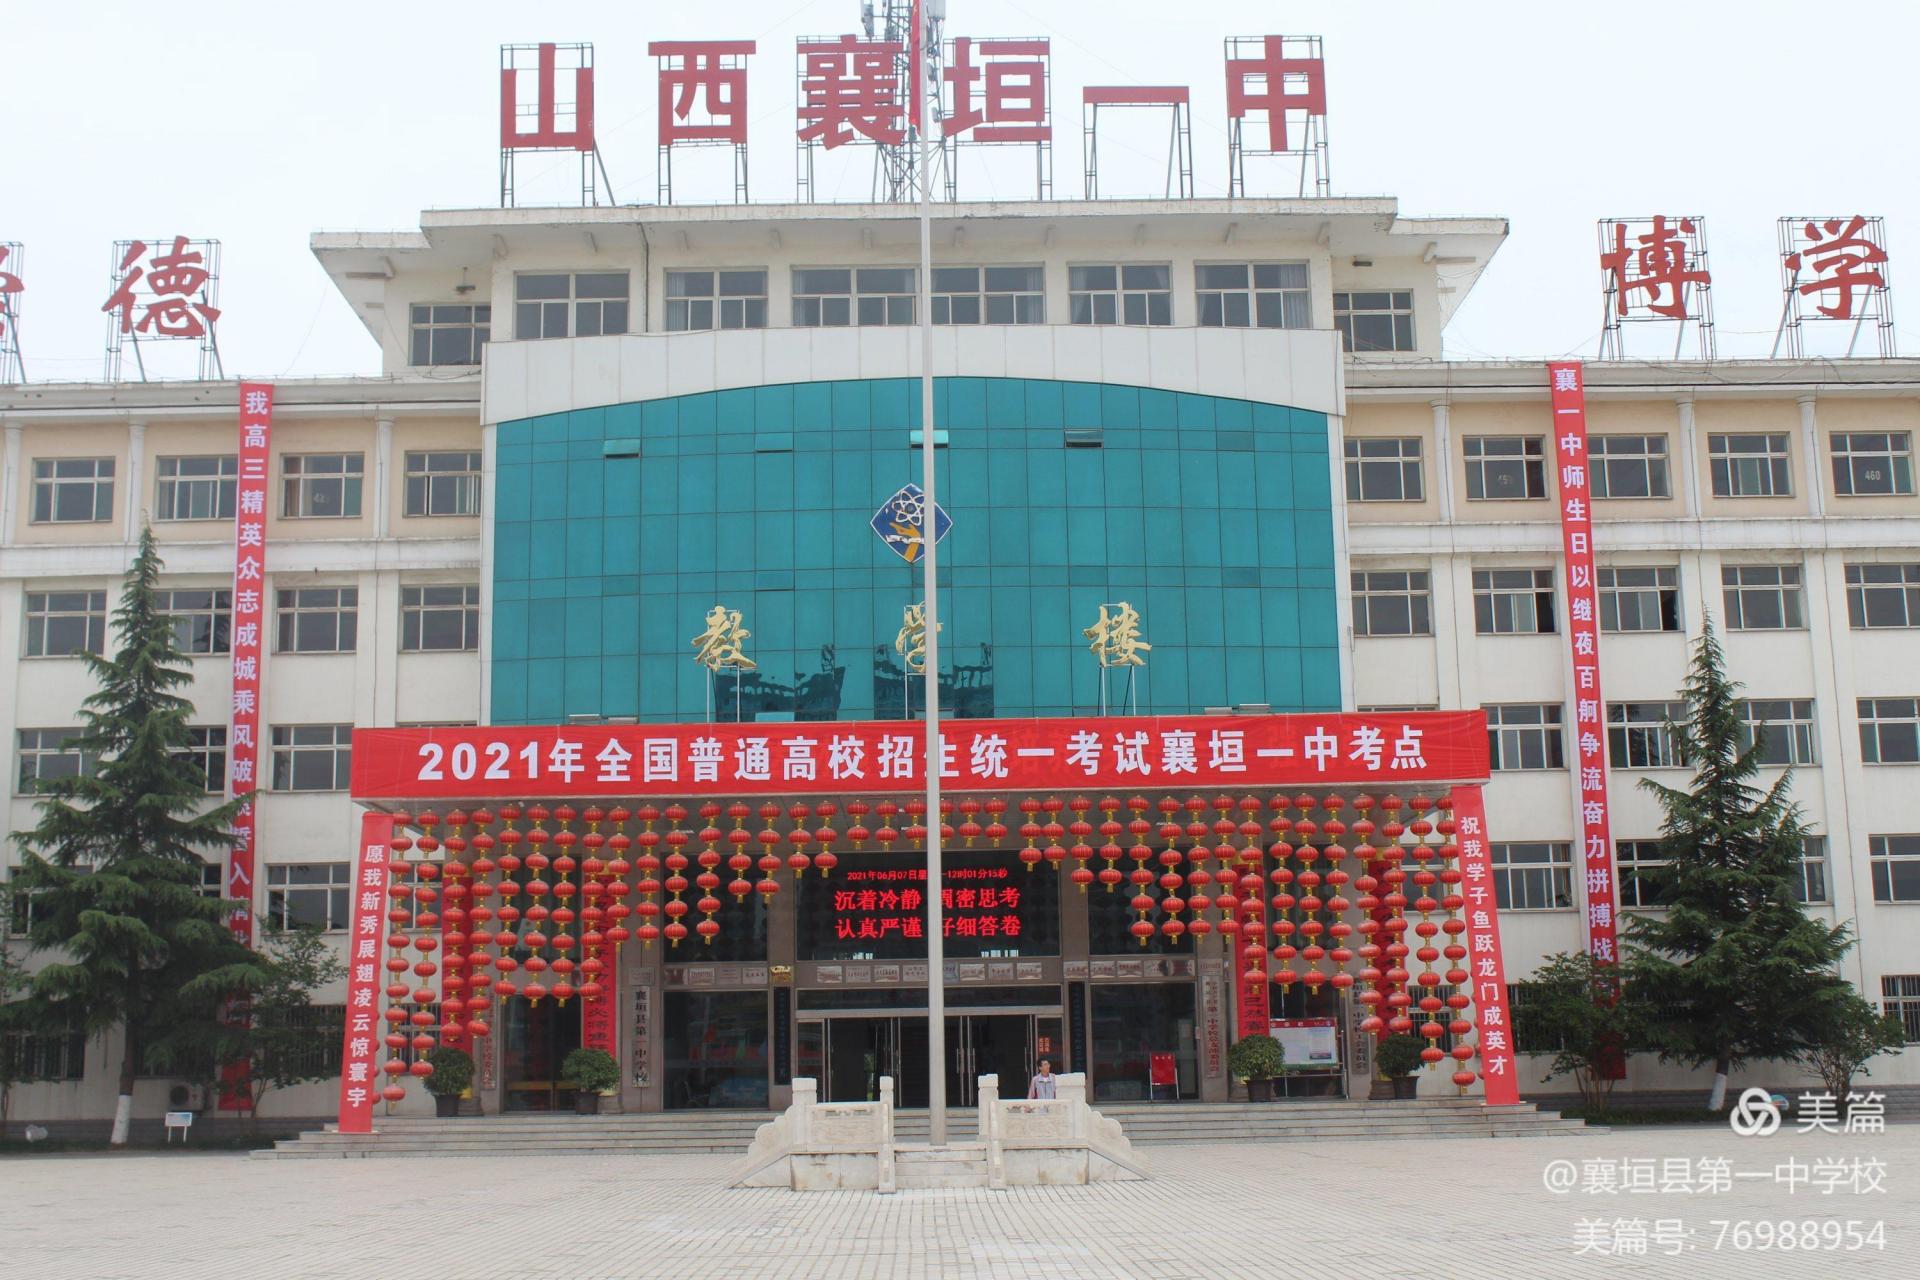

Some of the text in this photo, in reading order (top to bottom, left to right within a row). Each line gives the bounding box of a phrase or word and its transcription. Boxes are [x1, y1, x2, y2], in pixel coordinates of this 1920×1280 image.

[501, 34, 1327, 151] 山西襄垣一中
[1601, 214, 1889, 320] 博学
[1864, 470, 1881, 481] 460
[417, 725, 1428, 783] 2021年全国普通高校招生统一考试襄垣一中考点
[834, 889, 922, 911] 沉着冷静
[835, 917, 923, 939] 认真严谨
[347, 844, 385, 1108] 愿我新秀展翅凌云惊寰宇
[1461, 816, 1508, 1076] 祝我学子鱼跃龙门成英才
